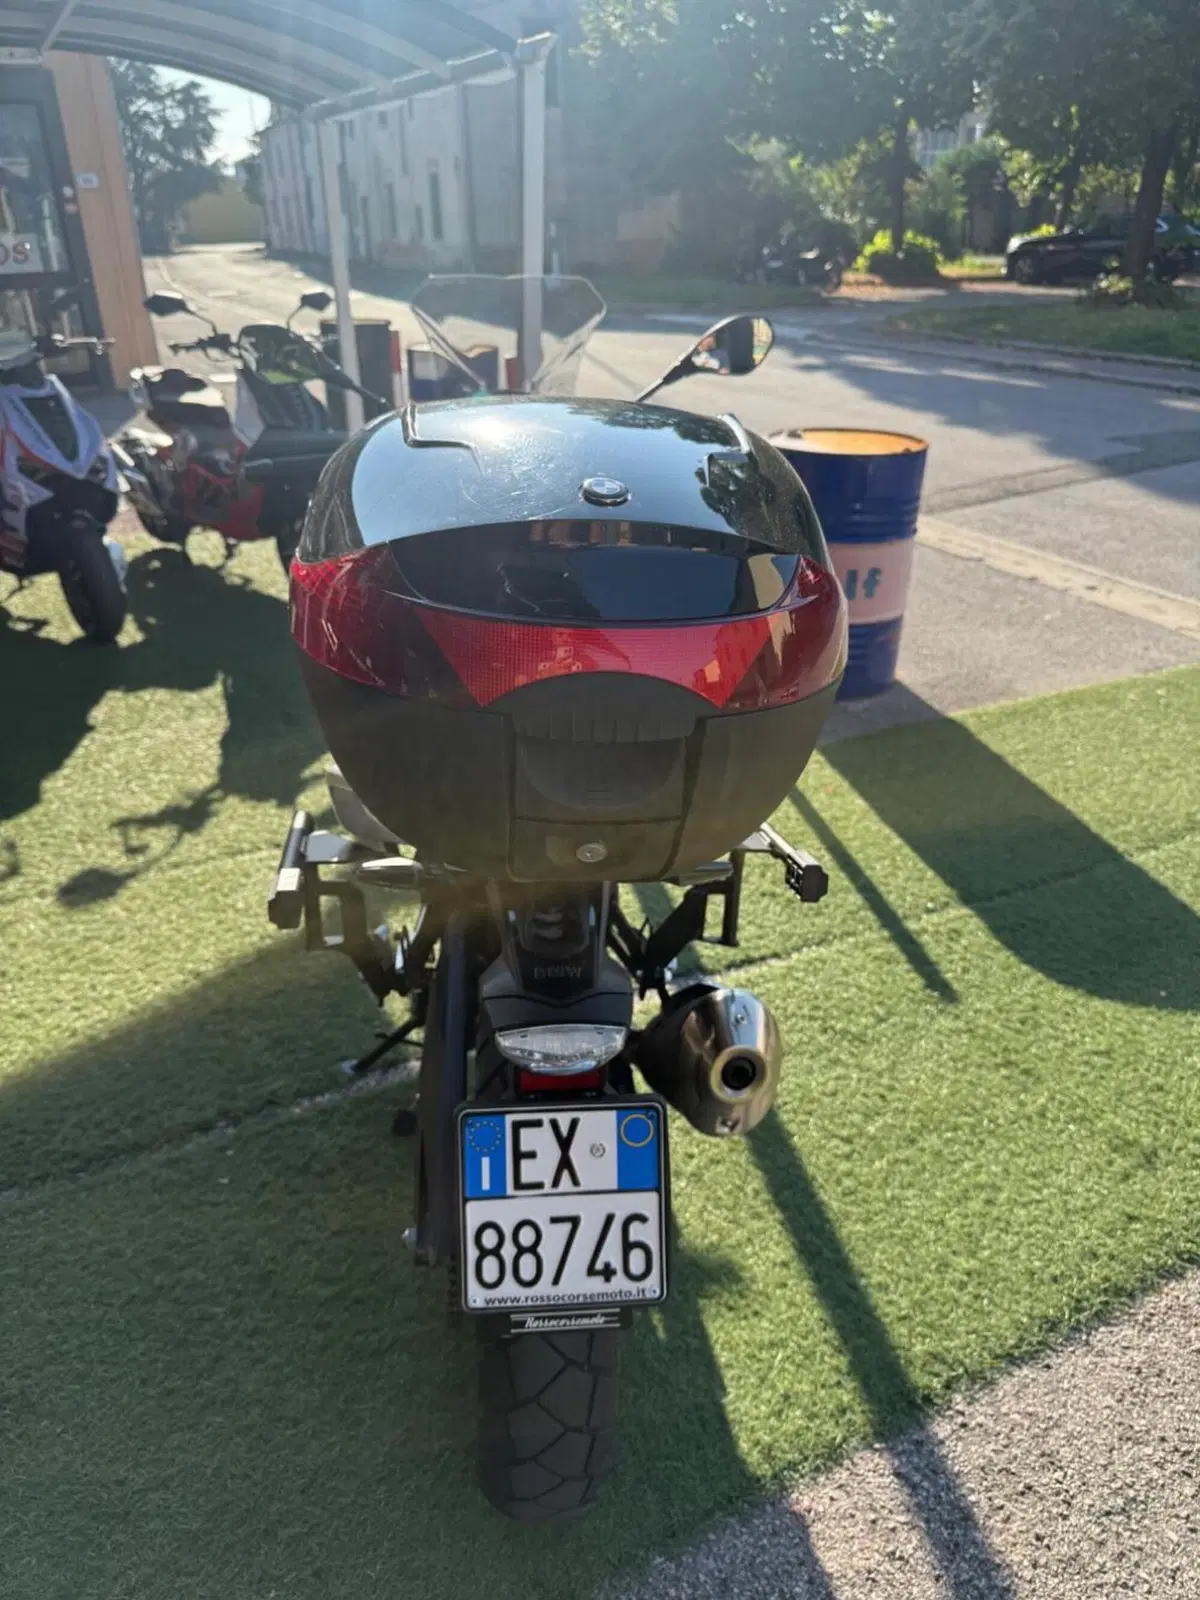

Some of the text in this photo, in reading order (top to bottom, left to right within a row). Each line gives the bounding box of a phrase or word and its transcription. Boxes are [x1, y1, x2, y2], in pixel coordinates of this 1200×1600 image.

[844, 566, 882, 601] lf
[511, 1117, 581, 1191] EX
[474, 1212, 653, 1291] 88746
[483, 1287, 647, 1307] www.rossocorsemoto.it
